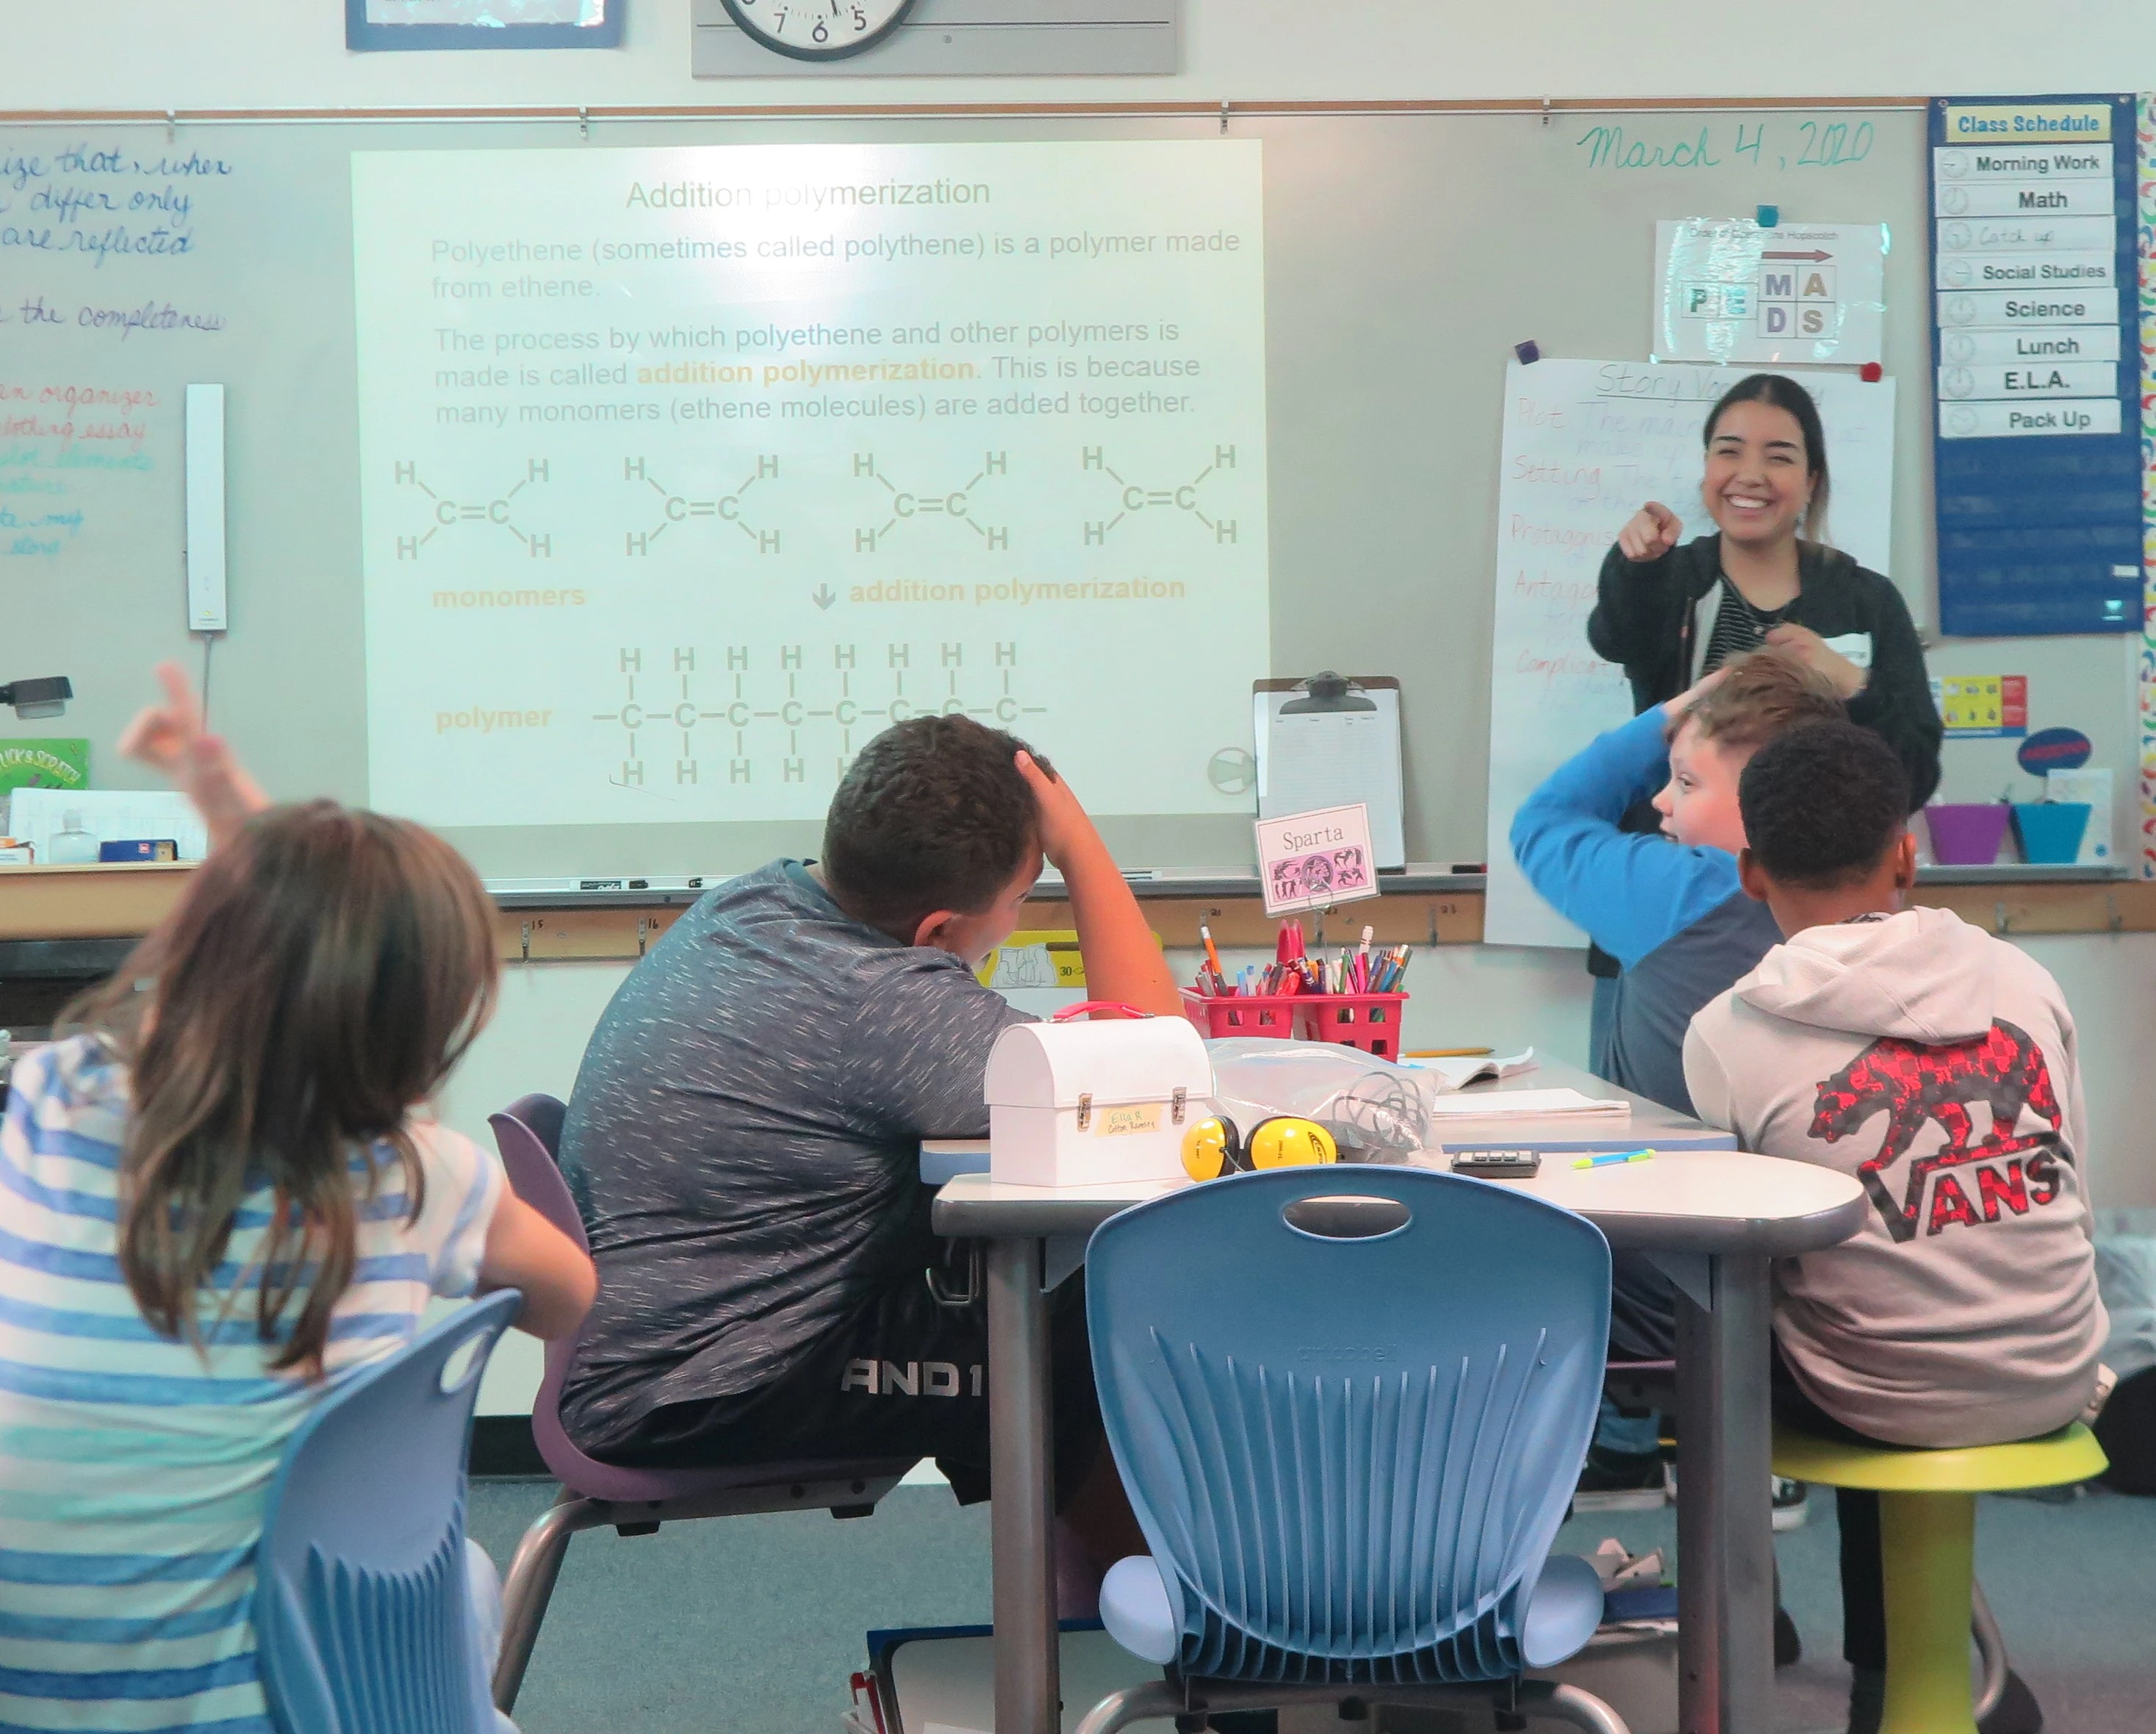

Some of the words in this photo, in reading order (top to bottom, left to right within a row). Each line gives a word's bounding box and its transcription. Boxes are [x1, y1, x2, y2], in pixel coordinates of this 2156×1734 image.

[774, 13, 786, 33] 7
[854, 10, 866, 30] 5
[812, 21, 828, 43] 6
[1958, 116, 2008, 133] Class
[2013, 115, 2100, 132] Schedule
[1575, 125, 1721, 168] March
[1798, 120, 1875, 166] 2020
[1977, 157, 2049, 173] Morning
[2054, 155, 2100, 170] Work
[129, 184, 193, 228] only
[626, 181, 752, 209] Addition
[766, 178, 990, 211] polymerization
[2019, 192, 2069, 208] Math
[433, 239, 582, 267] Polyethene
[592, 237, 747, 265] (sometimes
[758, 235, 833, 259] called
[845, 233, 984, 262] polythene)
[995, 233, 1015, 254] is
[1025, 237, 1040, 254] a
[1051, 231, 1157, 259] polymer
[1167, 230, 1240, 252] made
[1984, 265, 2035, 281] Social
[2041, 263, 2106, 280] Studies
[433, 276, 491, 298] from
[502, 276, 600, 298] ethene.
[1766, 274, 1792, 296] M
[1803, 273, 1828, 297] A
[1691, 289, 1708, 312] P
[2005, 301, 2085, 317] Science
[1767, 307, 1787, 333] D
[1802, 309, 1823, 334] S
[434, 328, 484, 352] The
[496, 330, 599, 356] process
[610, 327, 639, 353] by
[650, 325, 725, 349] which
[736, 323, 882, 353] polyethene
[891, 322, 940, 345] and
[951, 321, 1018, 344] other
[1029, 320, 1149, 348] polymers
[1160, 319, 1179, 341] is
[2017, 337, 2080, 355] Lunch
[435, 364, 509, 388] made
[520, 364, 539, 386] is
[550, 363, 627, 385] called
[637, 361, 752, 384] addition
[992, 356, 1048, 379] This
[1057, 356, 1077, 378] is
[1088, 354, 1200, 378] because
[2005, 371, 2070, 389] E.L.A.
[1596, 364, 1681, 406] Story
[436, 404, 507, 428] many
[520, 399, 660, 422] monomers
[671, 397, 771, 425] (ethene
[781, 395, 925, 421] molecules)
[935, 396, 977, 417] are
[987, 392, 1068, 415] added
[1079, 392, 1194, 419] together.
[2009, 411, 2057, 428] Pack
[2063, 411, 2091, 430] Up
[758, 455, 778, 478] H
[854, 453, 874, 477] H
[986, 451, 1006, 475] H
[1082, 446, 1102, 470] H
[1215, 445, 1236, 468] H
[395, 461, 415, 484] H
[528, 458, 549, 482] H
[625, 457, 644, 481] H
[760, 530, 780, 553] H
[855, 528, 875, 552] H
[988, 527, 1007, 550] H
[1084, 522, 1104, 545] H
[1216, 519, 1236, 544] H
[1511, 514, 1615, 553] Protagonis
[397, 536, 417, 559] H
[531, 534, 550, 558] H
[626, 532, 647, 555] H
[433, 588, 585, 608] monomers
[849, 579, 965, 602] addition
[975, 575, 1185, 605] polymerization
[436, 706, 553, 733] polymer
[1283, 827, 1344, 852] Sparta
[532, 919, 544, 930] 15
[648, 918, 659, 930] 16
[1060, 966, 1072, 976] 30
[1135, 1111, 1143, 1120] R
[1858, 1134, 2071, 1243] VANS
